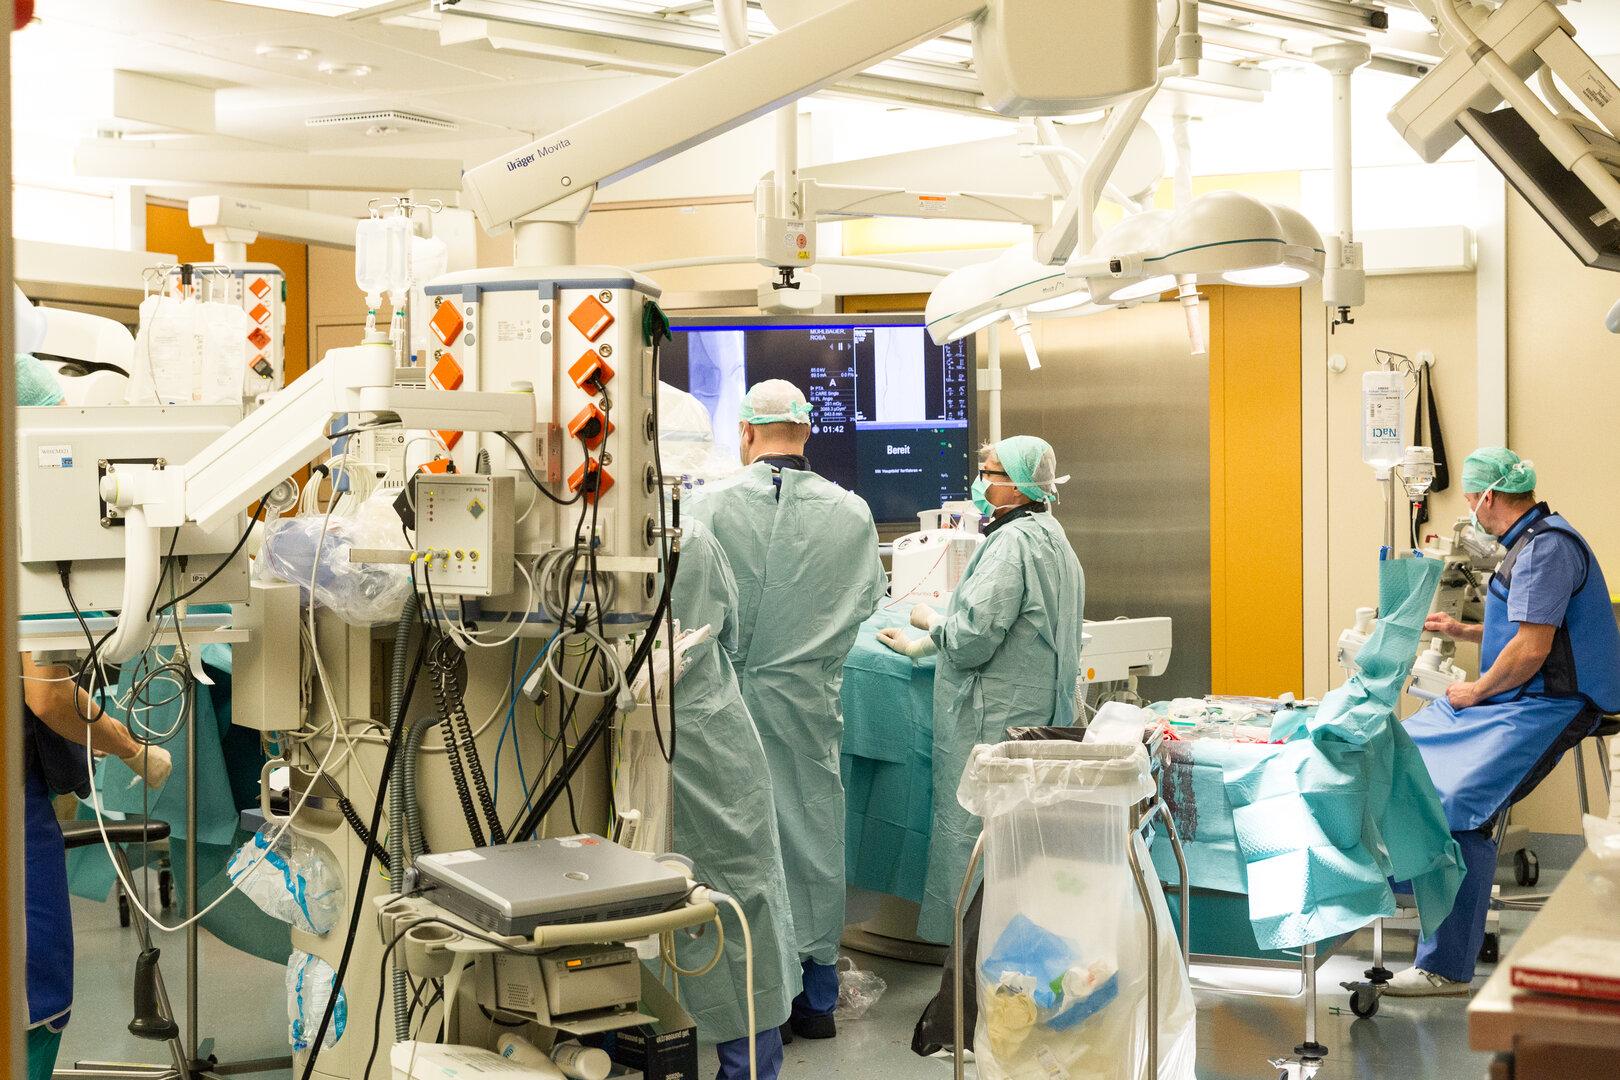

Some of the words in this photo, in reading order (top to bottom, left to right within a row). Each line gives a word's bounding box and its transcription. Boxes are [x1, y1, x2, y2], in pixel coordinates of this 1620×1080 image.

[506, 154, 535, 171] Dräger
[537, 139, 571, 158] Movita
[829, 378, 837, 387] A
[822, 425, 844, 433] 01:42
[1372, 428, 1396, 438] NaCl
[886, 445, 910, 455] Bereit
